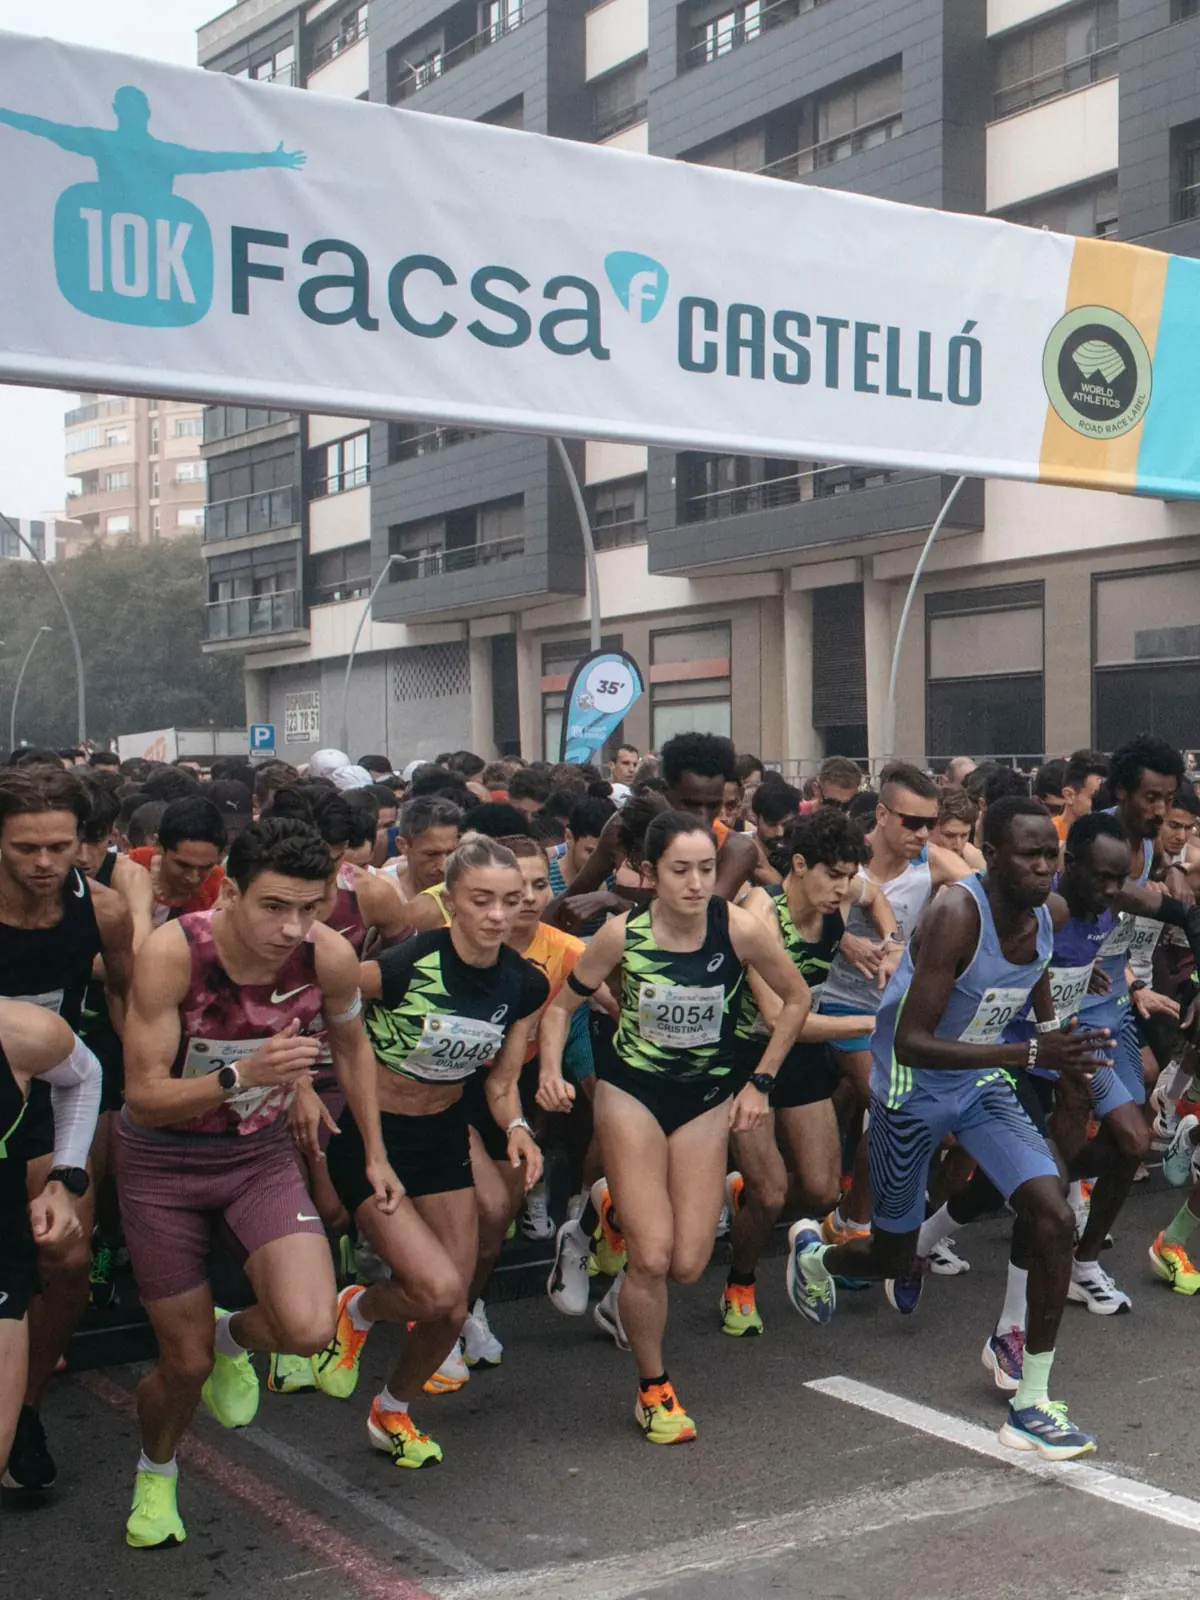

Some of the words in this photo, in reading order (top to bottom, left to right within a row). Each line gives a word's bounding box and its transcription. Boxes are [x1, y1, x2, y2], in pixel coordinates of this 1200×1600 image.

[80, 207, 197, 304] 10K
[231, 226, 611, 361] Facsa
[678, 296, 982, 406] CASTELLÓ
[1073, 392, 1120, 408] ATHLETICS
[1081, 383, 1114, 397] WORLD
[1079, 420, 1104, 434] ROAD
[1106, 418, 1128, 433] RACE
[1127, 392, 1146, 421] LABEL
[254, 727, 271, 747] P
[656, 1004, 715, 1025] 2054
[657, 1022, 704, 1034] CRISTINA
[432, 1038, 493, 1060] 2048
